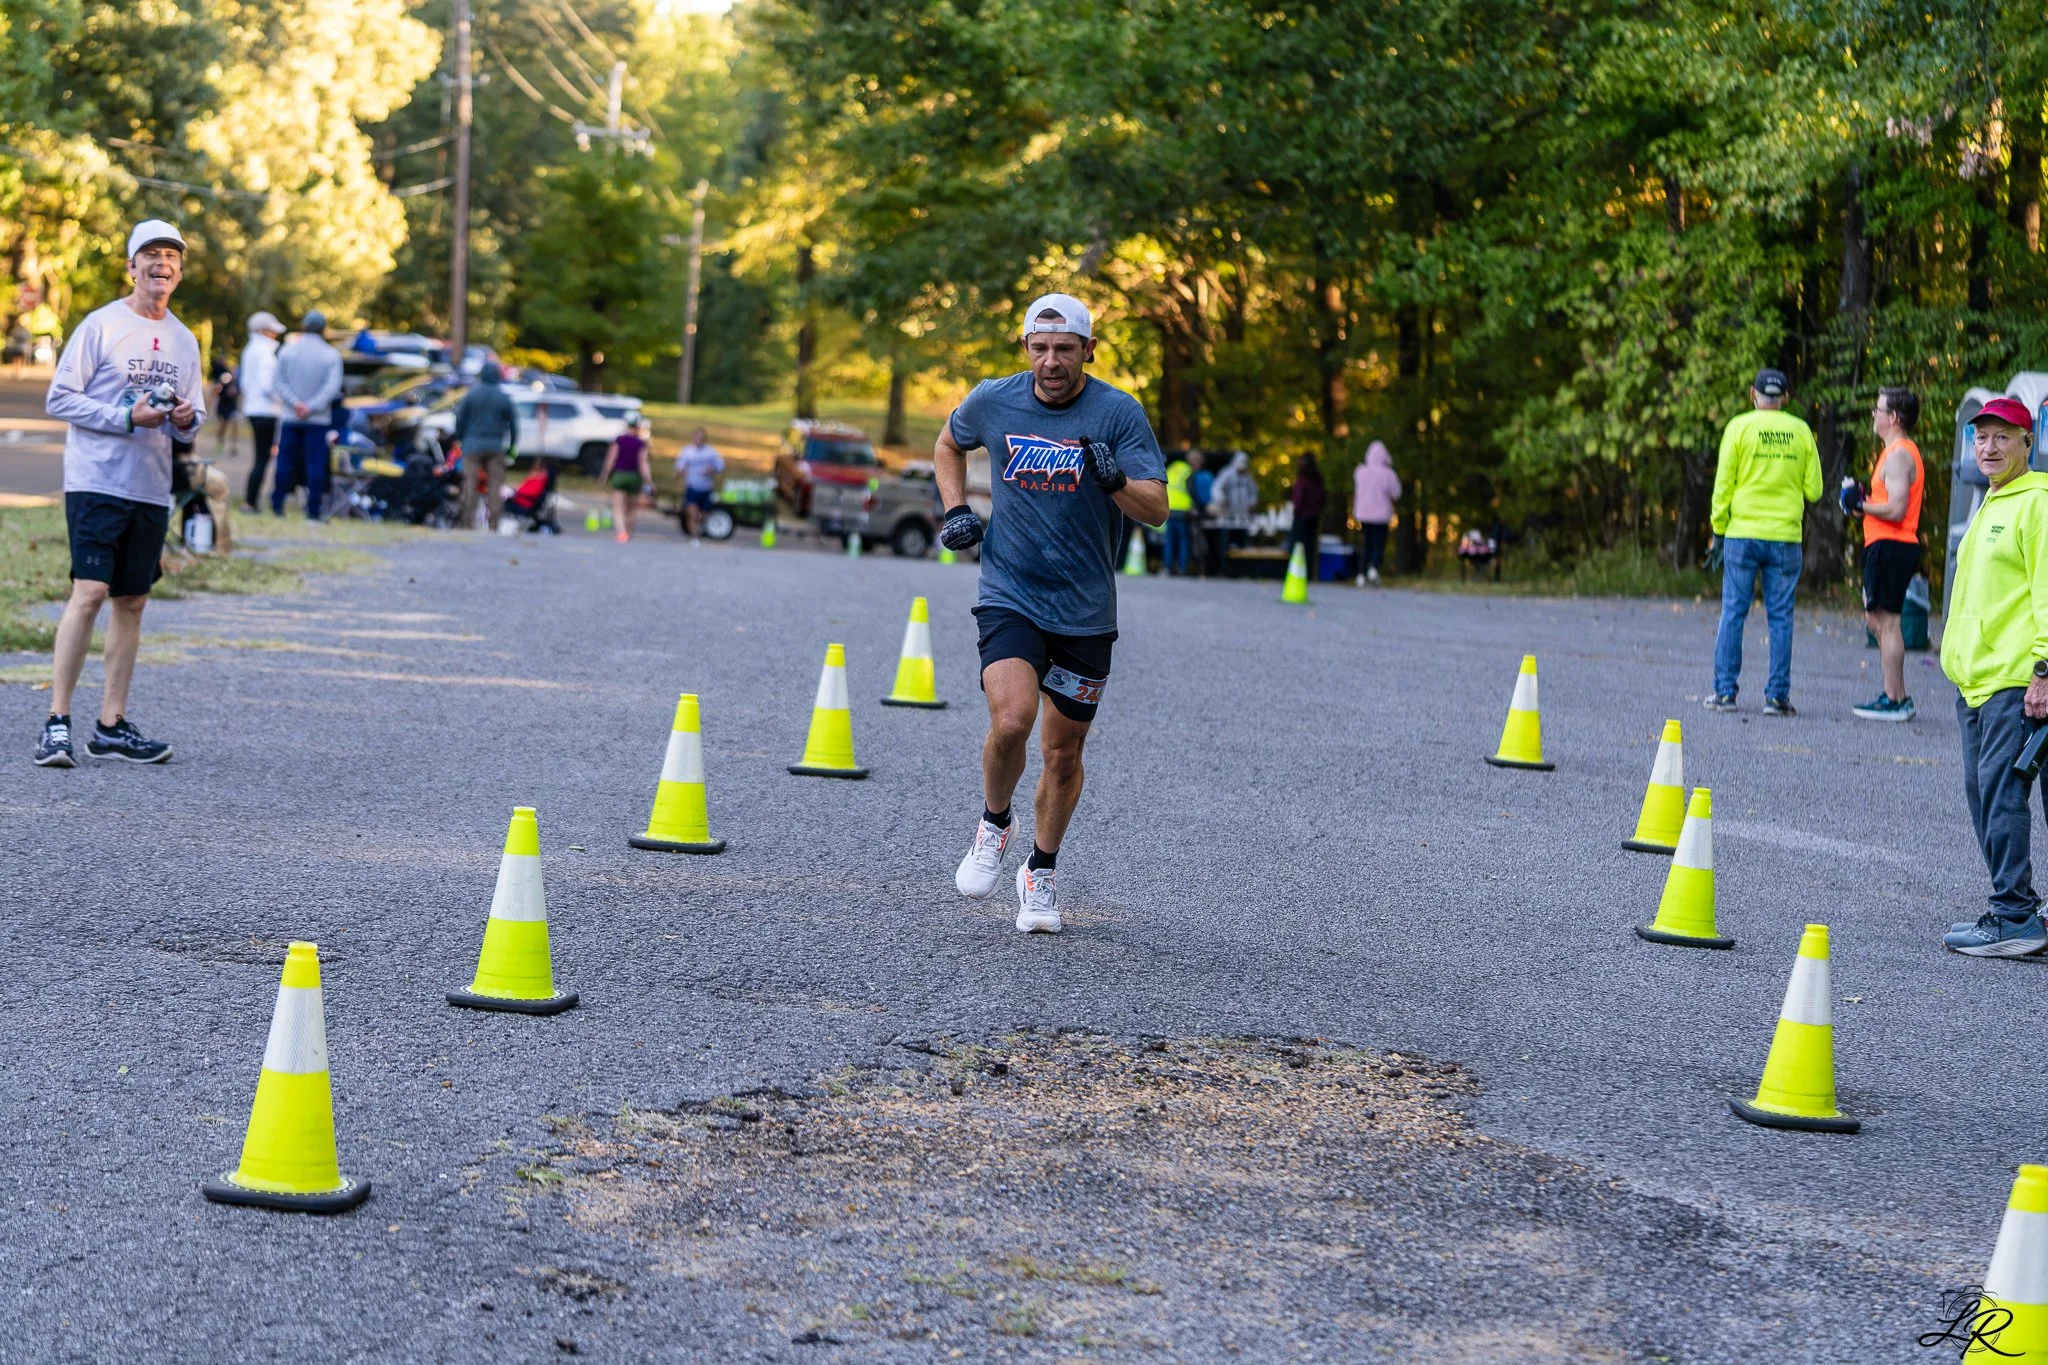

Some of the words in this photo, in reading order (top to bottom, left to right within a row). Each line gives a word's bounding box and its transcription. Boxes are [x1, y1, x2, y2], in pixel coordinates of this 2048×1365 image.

[128, 359, 146, 371] ST.
[148, 360, 179, 378] JUDE
[1020, 480, 1076, 492] RACING
